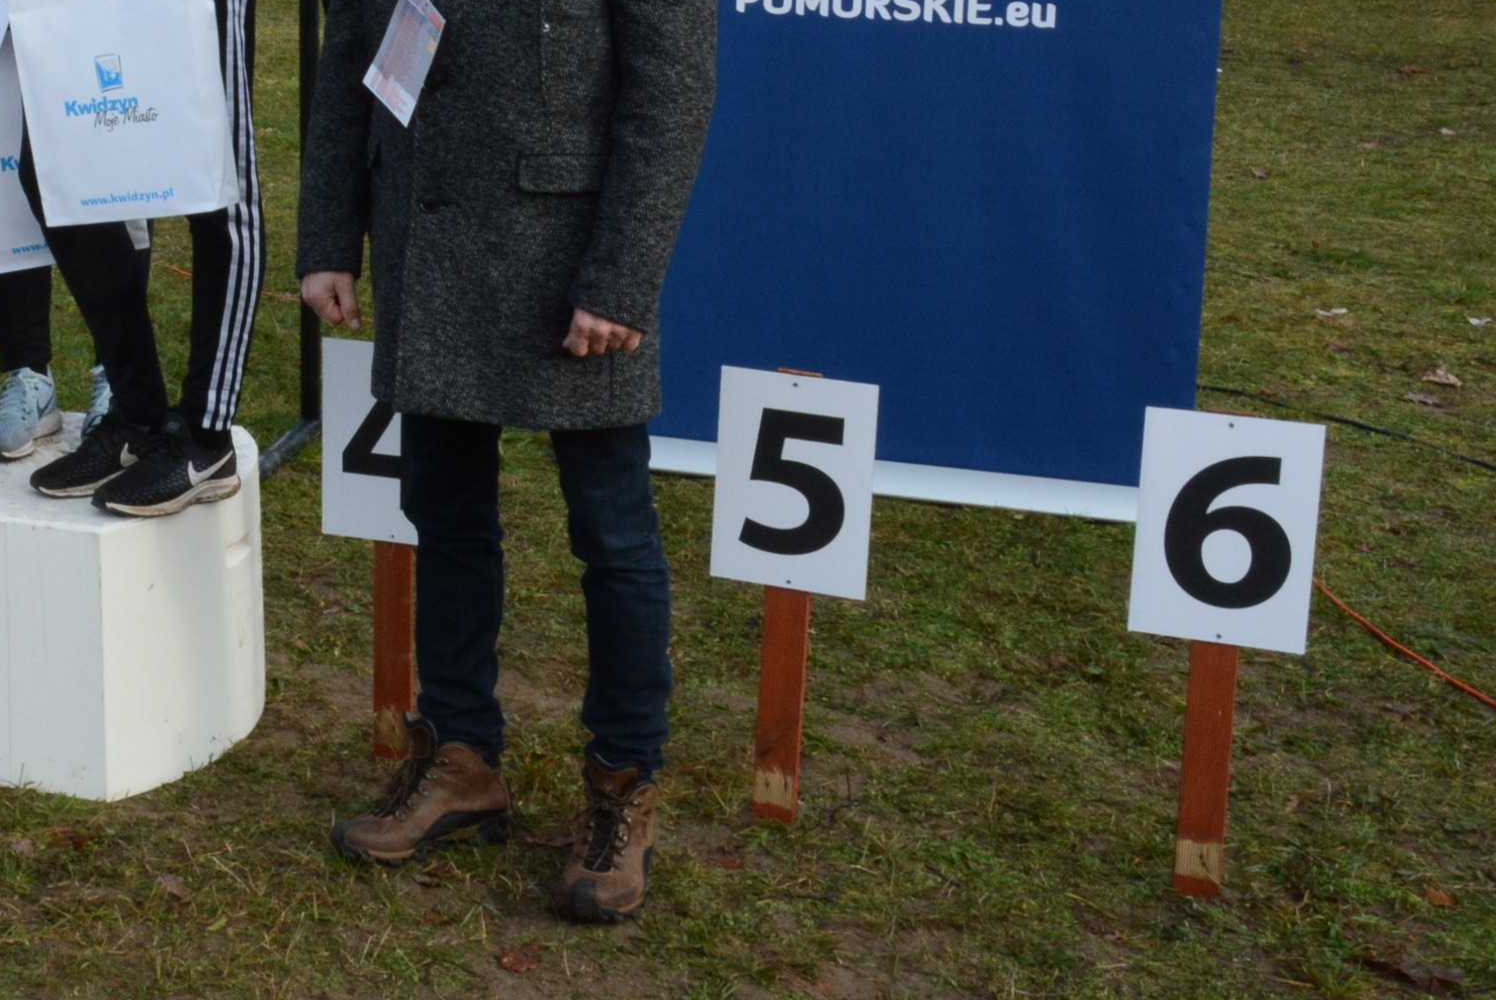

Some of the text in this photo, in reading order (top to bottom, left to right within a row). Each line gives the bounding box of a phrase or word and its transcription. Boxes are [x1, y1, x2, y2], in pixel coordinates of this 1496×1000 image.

[64, 96, 140, 118] Kwidzyn
[93, 107, 159, 133] Moje Miasto
[79, 188, 175, 208] www.kwidzyn.pl
[738, 406, 847, 557] 5
[1163, 455, 1294, 610] 6
